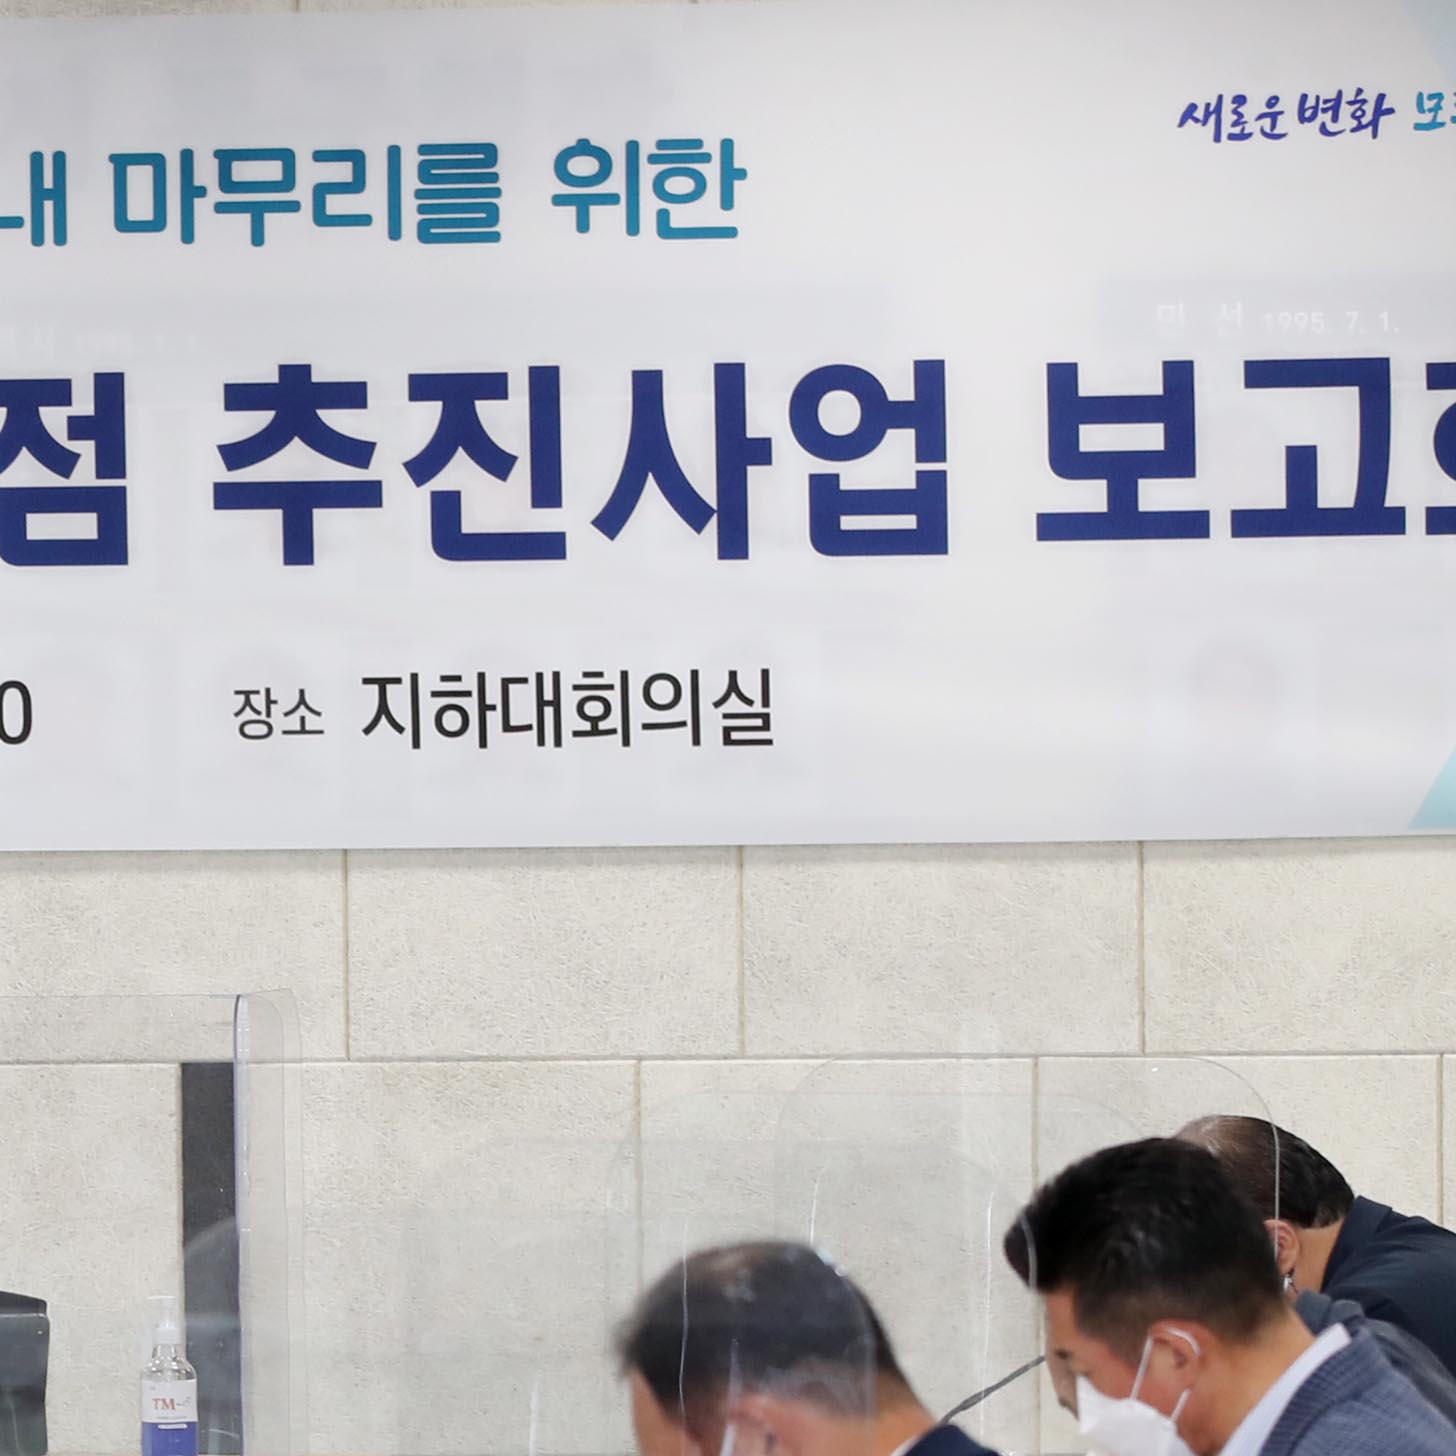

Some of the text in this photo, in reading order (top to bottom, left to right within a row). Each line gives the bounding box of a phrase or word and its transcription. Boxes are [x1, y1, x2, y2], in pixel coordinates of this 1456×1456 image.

[1412, 91, 1456, 132] 모
[106, 140, 504, 249] 마무리를
[550, 136, 749, 241] 위한
[211, 357, 950, 568] 추진사업
[1034, 355, 1456, 543] 보고
[232, 685, 326, 742] 장소
[360, 666, 775, 751] 지하대회의실
